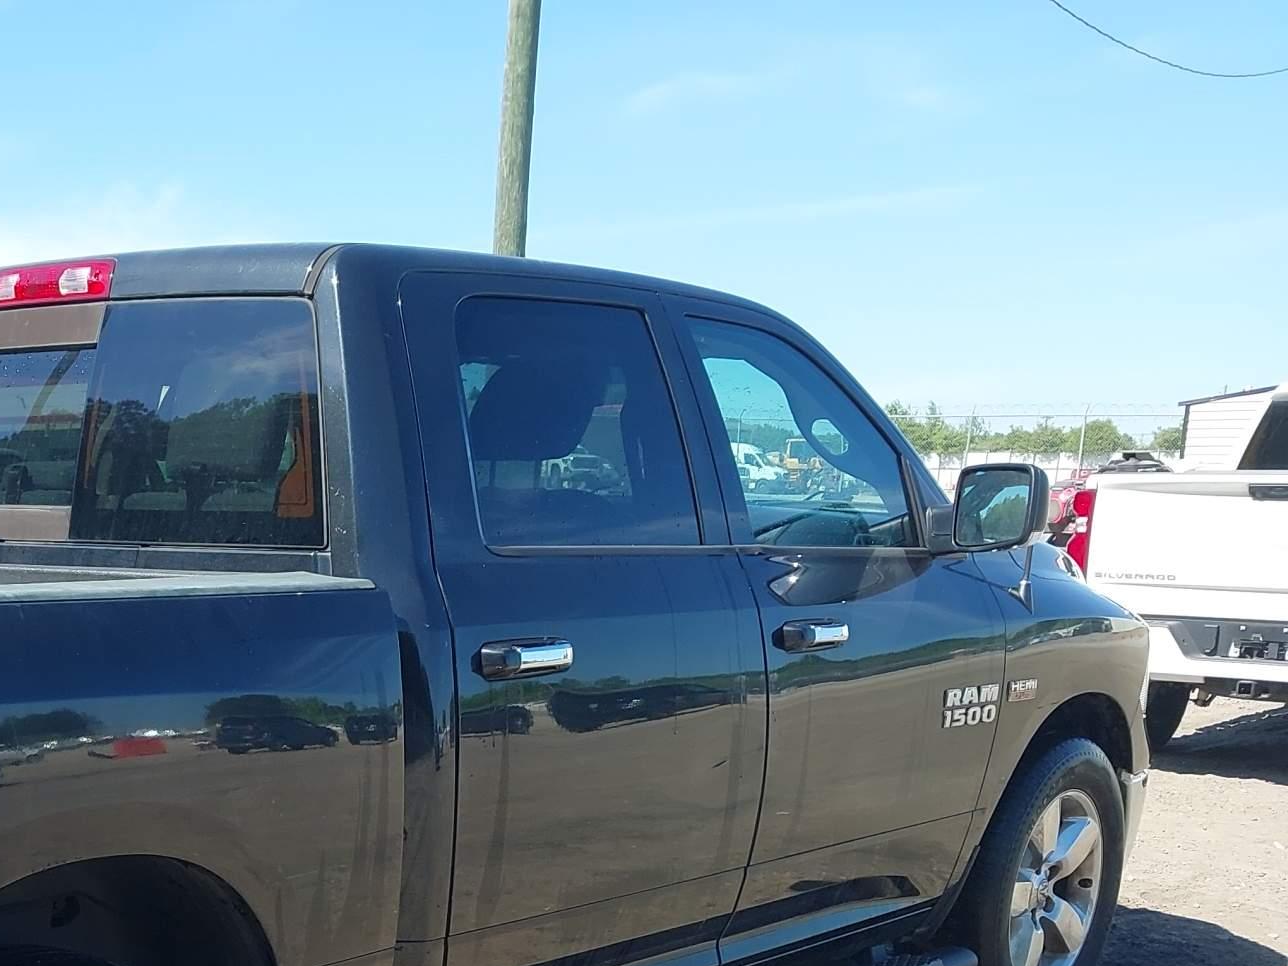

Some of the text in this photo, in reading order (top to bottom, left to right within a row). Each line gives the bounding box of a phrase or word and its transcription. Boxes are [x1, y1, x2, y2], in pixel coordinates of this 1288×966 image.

[1094, 571, 1177, 581] SILVERADO
[1011, 679, 1038, 691] HEMI
[945, 683, 1000, 708] RAM
[943, 704, 997, 729] 1500
